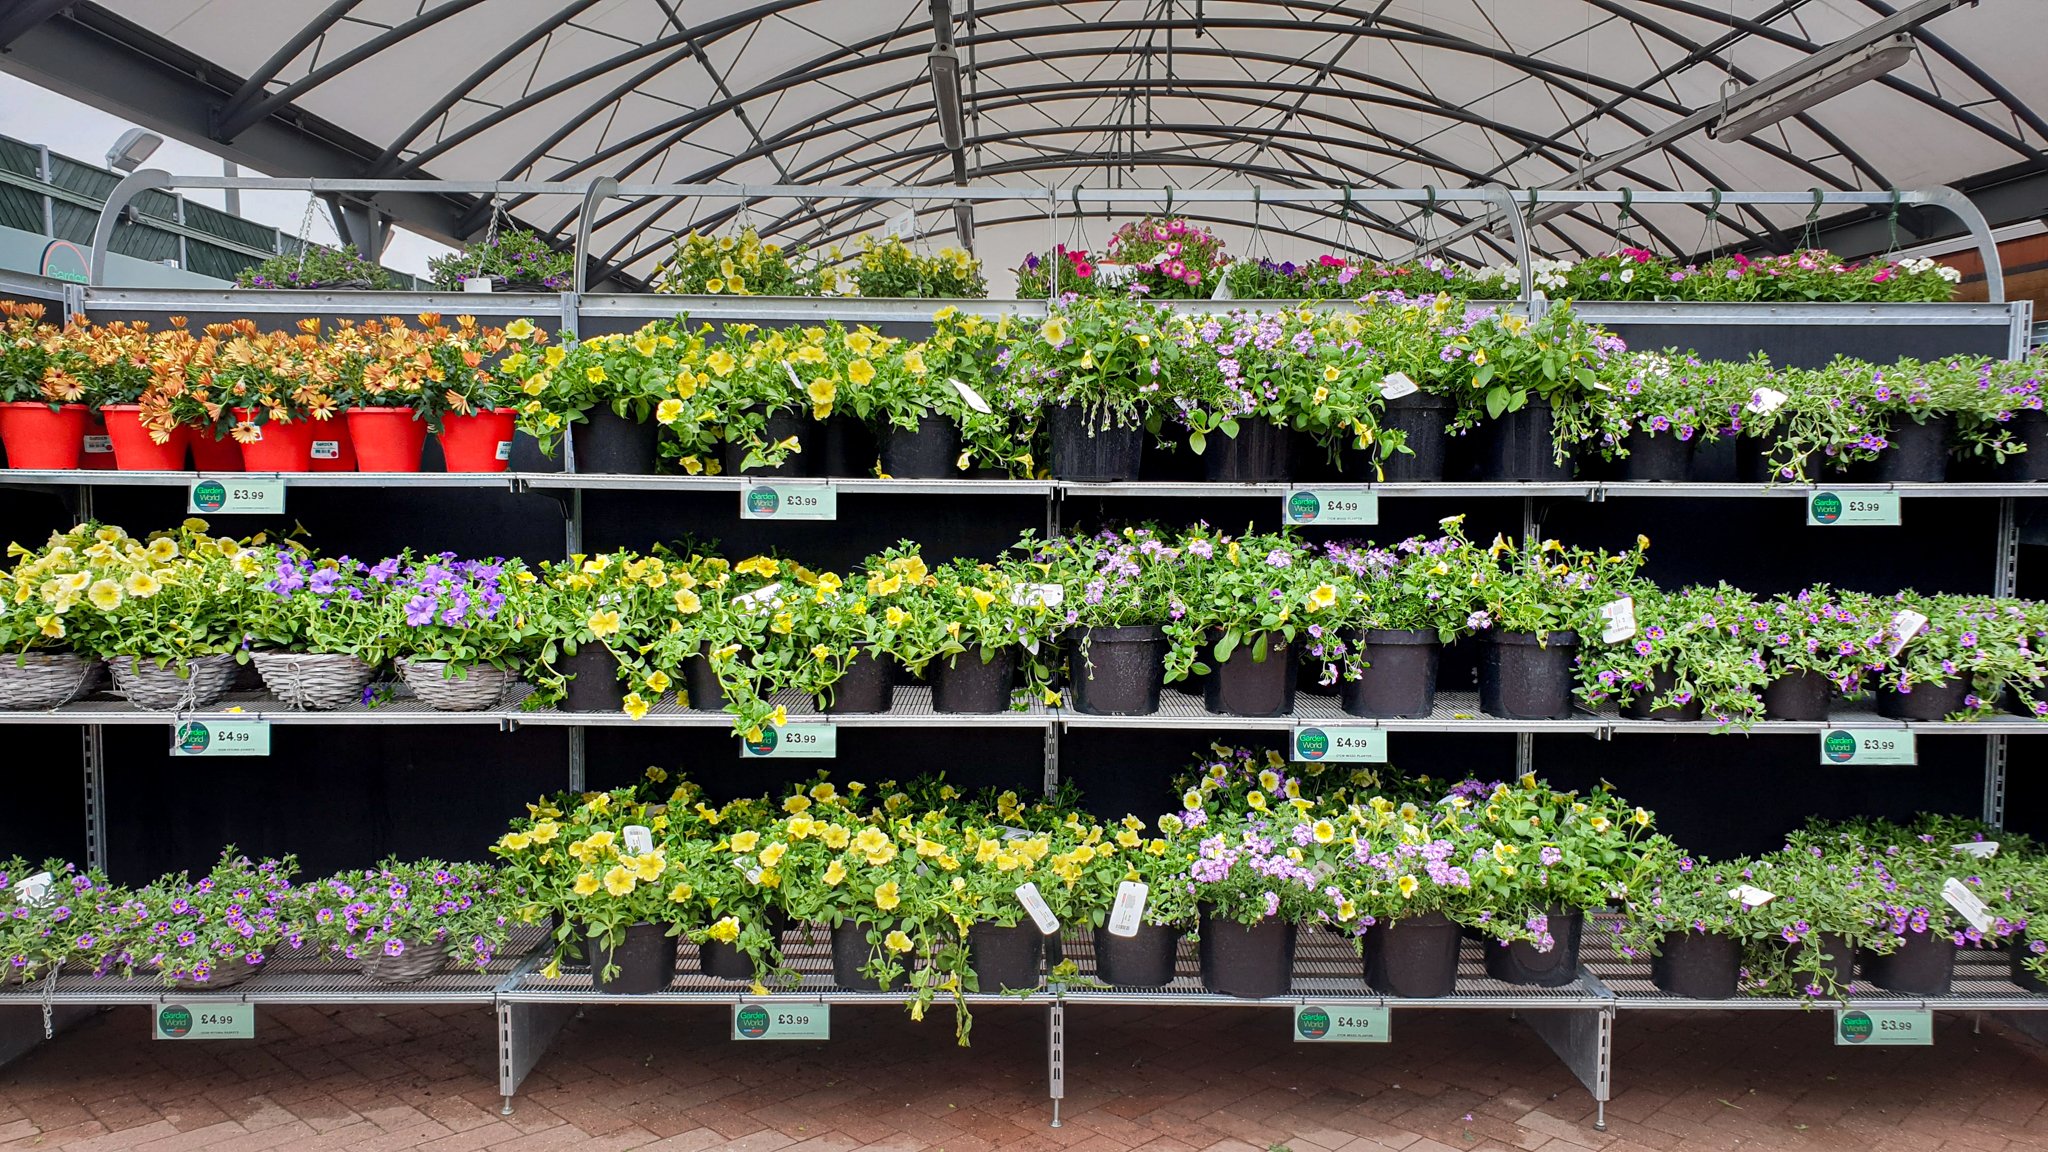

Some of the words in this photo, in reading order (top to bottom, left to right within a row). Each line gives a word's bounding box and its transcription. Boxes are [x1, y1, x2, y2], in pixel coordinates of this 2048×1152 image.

[47, 264, 88, 283] Garden
[234, 490, 263, 499] £3.99
[787, 496, 816, 505] £3.99
[1328, 501, 1357, 510] £4.99
[1850, 502, 1879, 511] £3.99
[218, 731, 249, 741] £4.99
[786, 733, 816, 743] £3.99
[1337, 738, 1366, 747] £4.99
[1864, 740, 1894, 749] £3.99
[201, 1014, 232, 1024] £4.99
[778, 1014, 809, 1024] £3.99
[1338, 1017, 1368, 1027] £4.99
[1881, 1020, 1911, 1030] £3.99
